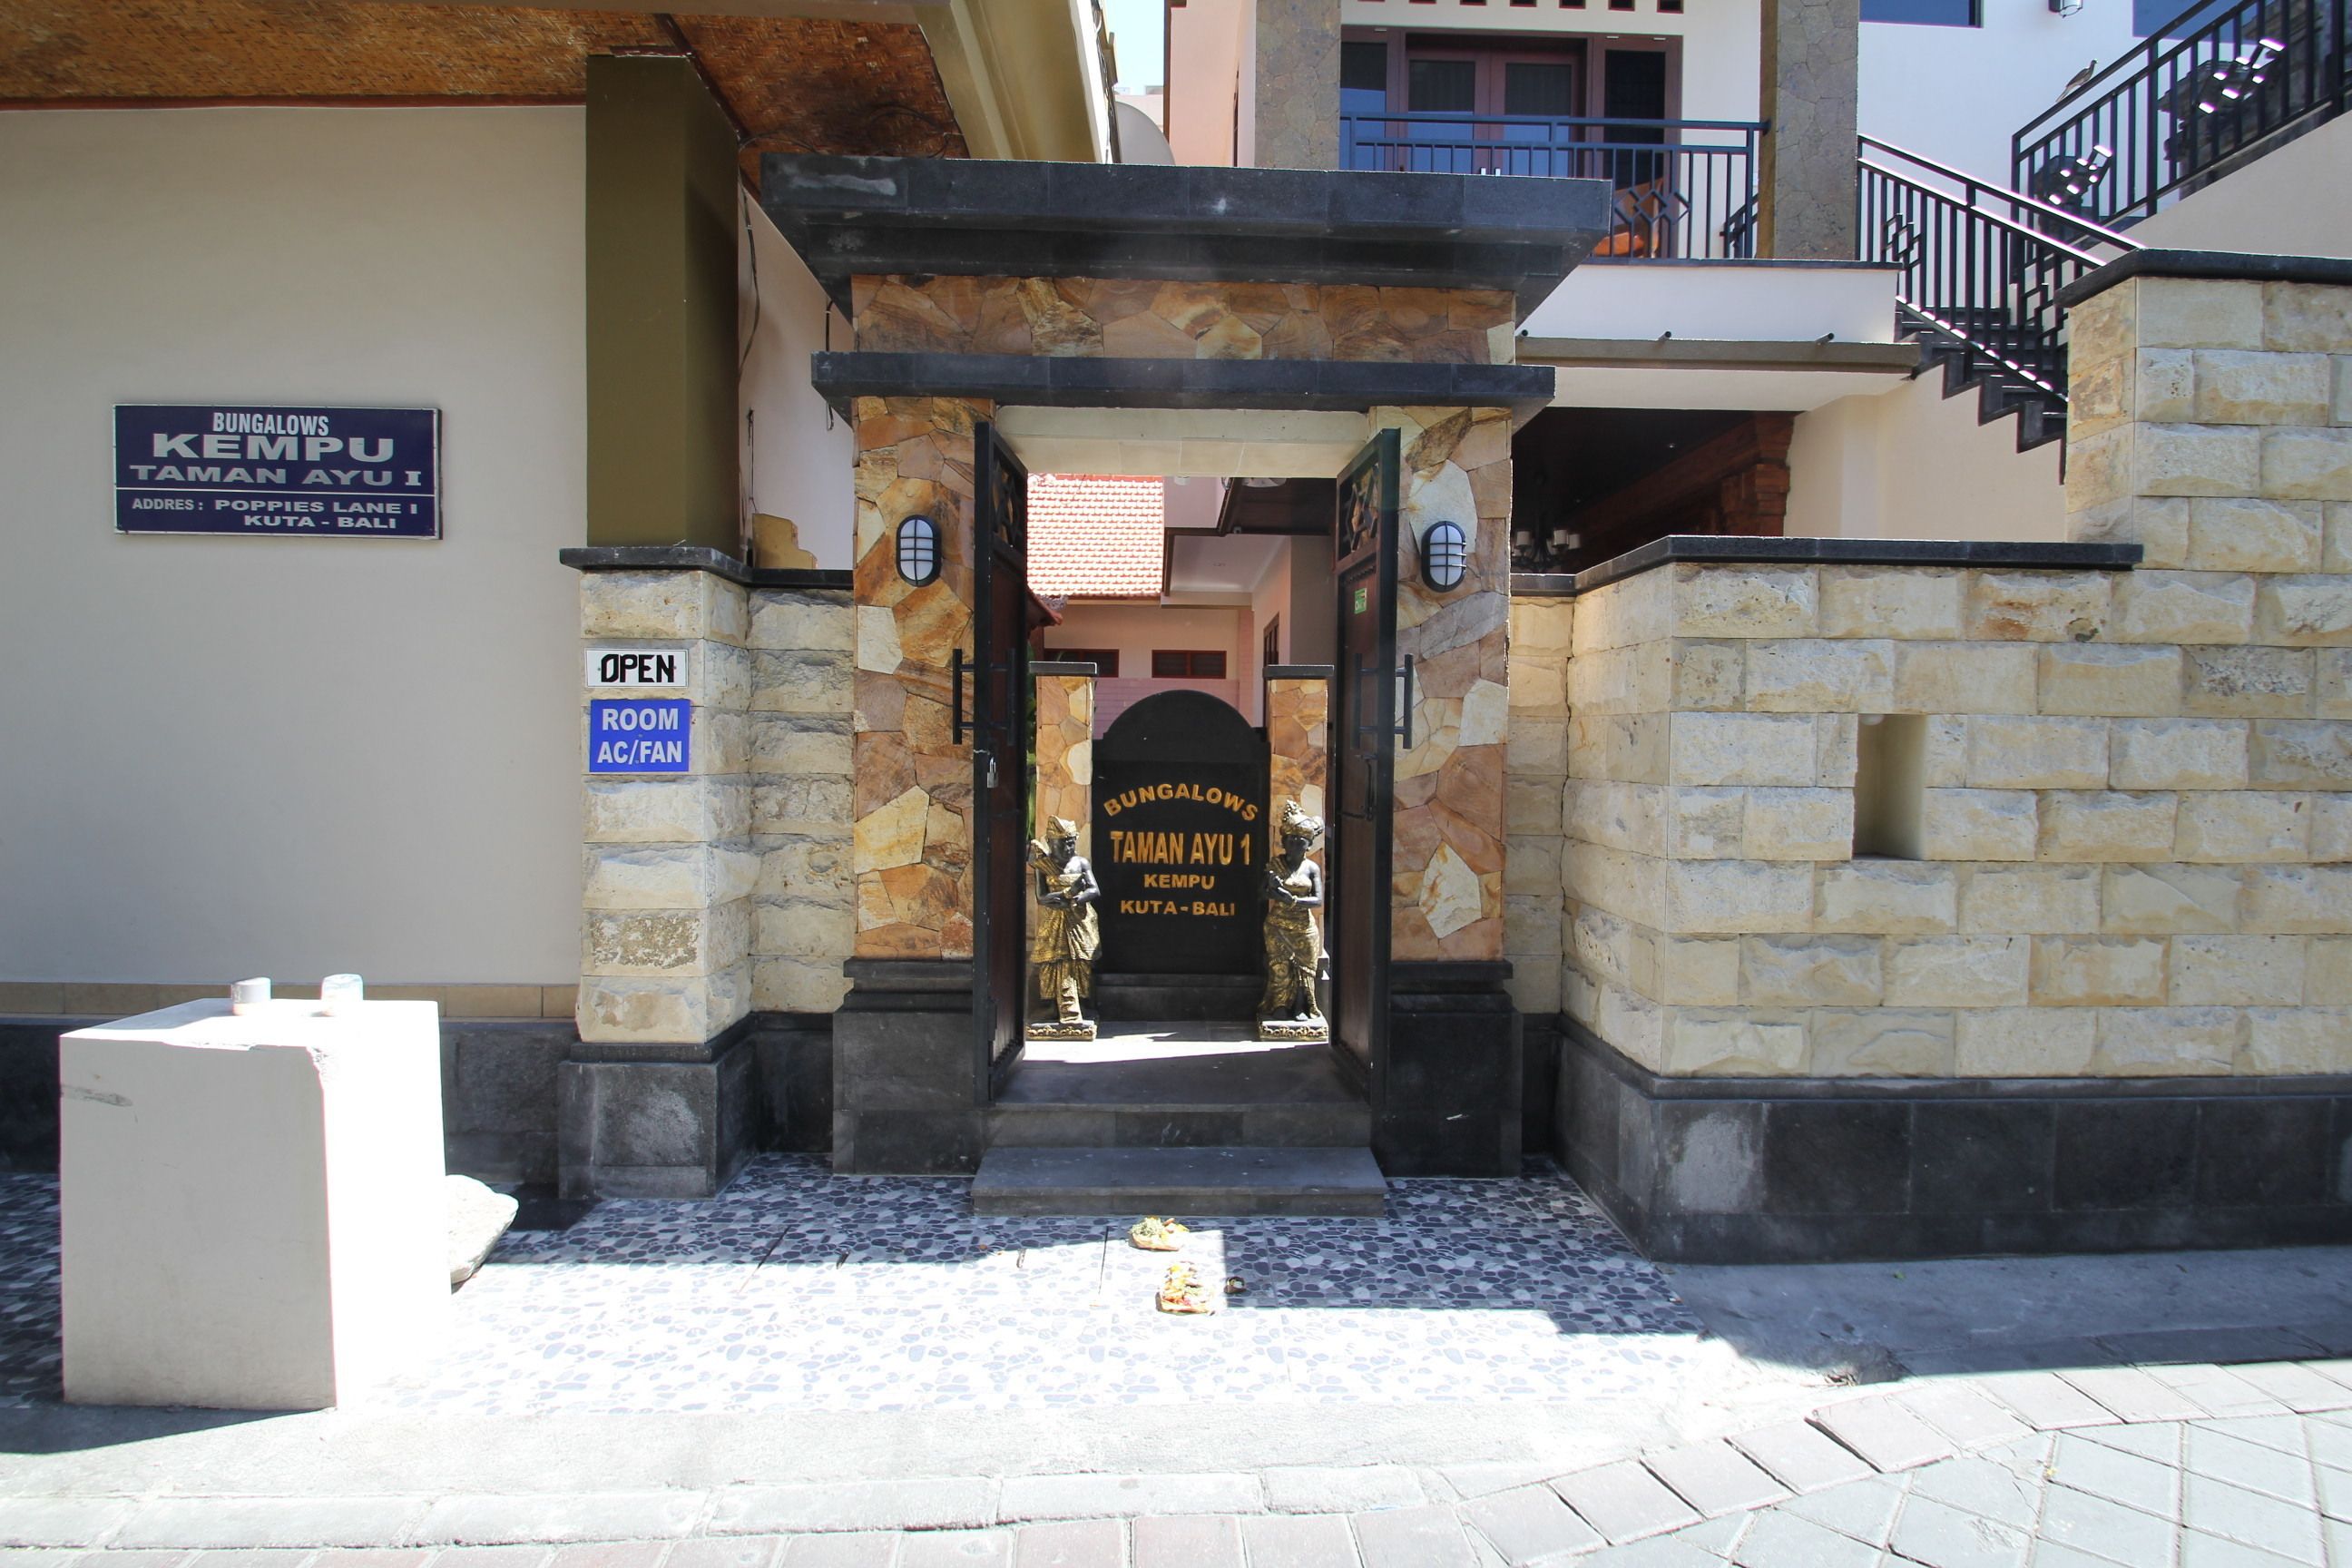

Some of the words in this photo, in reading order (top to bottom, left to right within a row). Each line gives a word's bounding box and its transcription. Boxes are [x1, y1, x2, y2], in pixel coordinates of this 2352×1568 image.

[213, 412, 328, 436] BUNGALOWS
[152, 433, 394, 463] KEMPU
[130, 465, 287, 485] TAMAN
[301, 469, 392, 486] AYU
[214, 500, 324, 513] POPPIES
[332, 503, 401, 514] LANE
[243, 514, 315, 527] KUTA
[338, 516, 397, 528] BALI
[601, 653, 674, 682] OPEN
[602, 708, 679, 730] ROOM
[597, 740, 682, 765] AC/FAN
[1103, 783, 1259, 821] BUNGALOWS
[1111, 831, 1183, 865] TAMAN
[1191, 833, 1233, 866] AYU
[1240, 833, 1250, 866] 1
[1144, 874, 1215, 889] KEMPU
